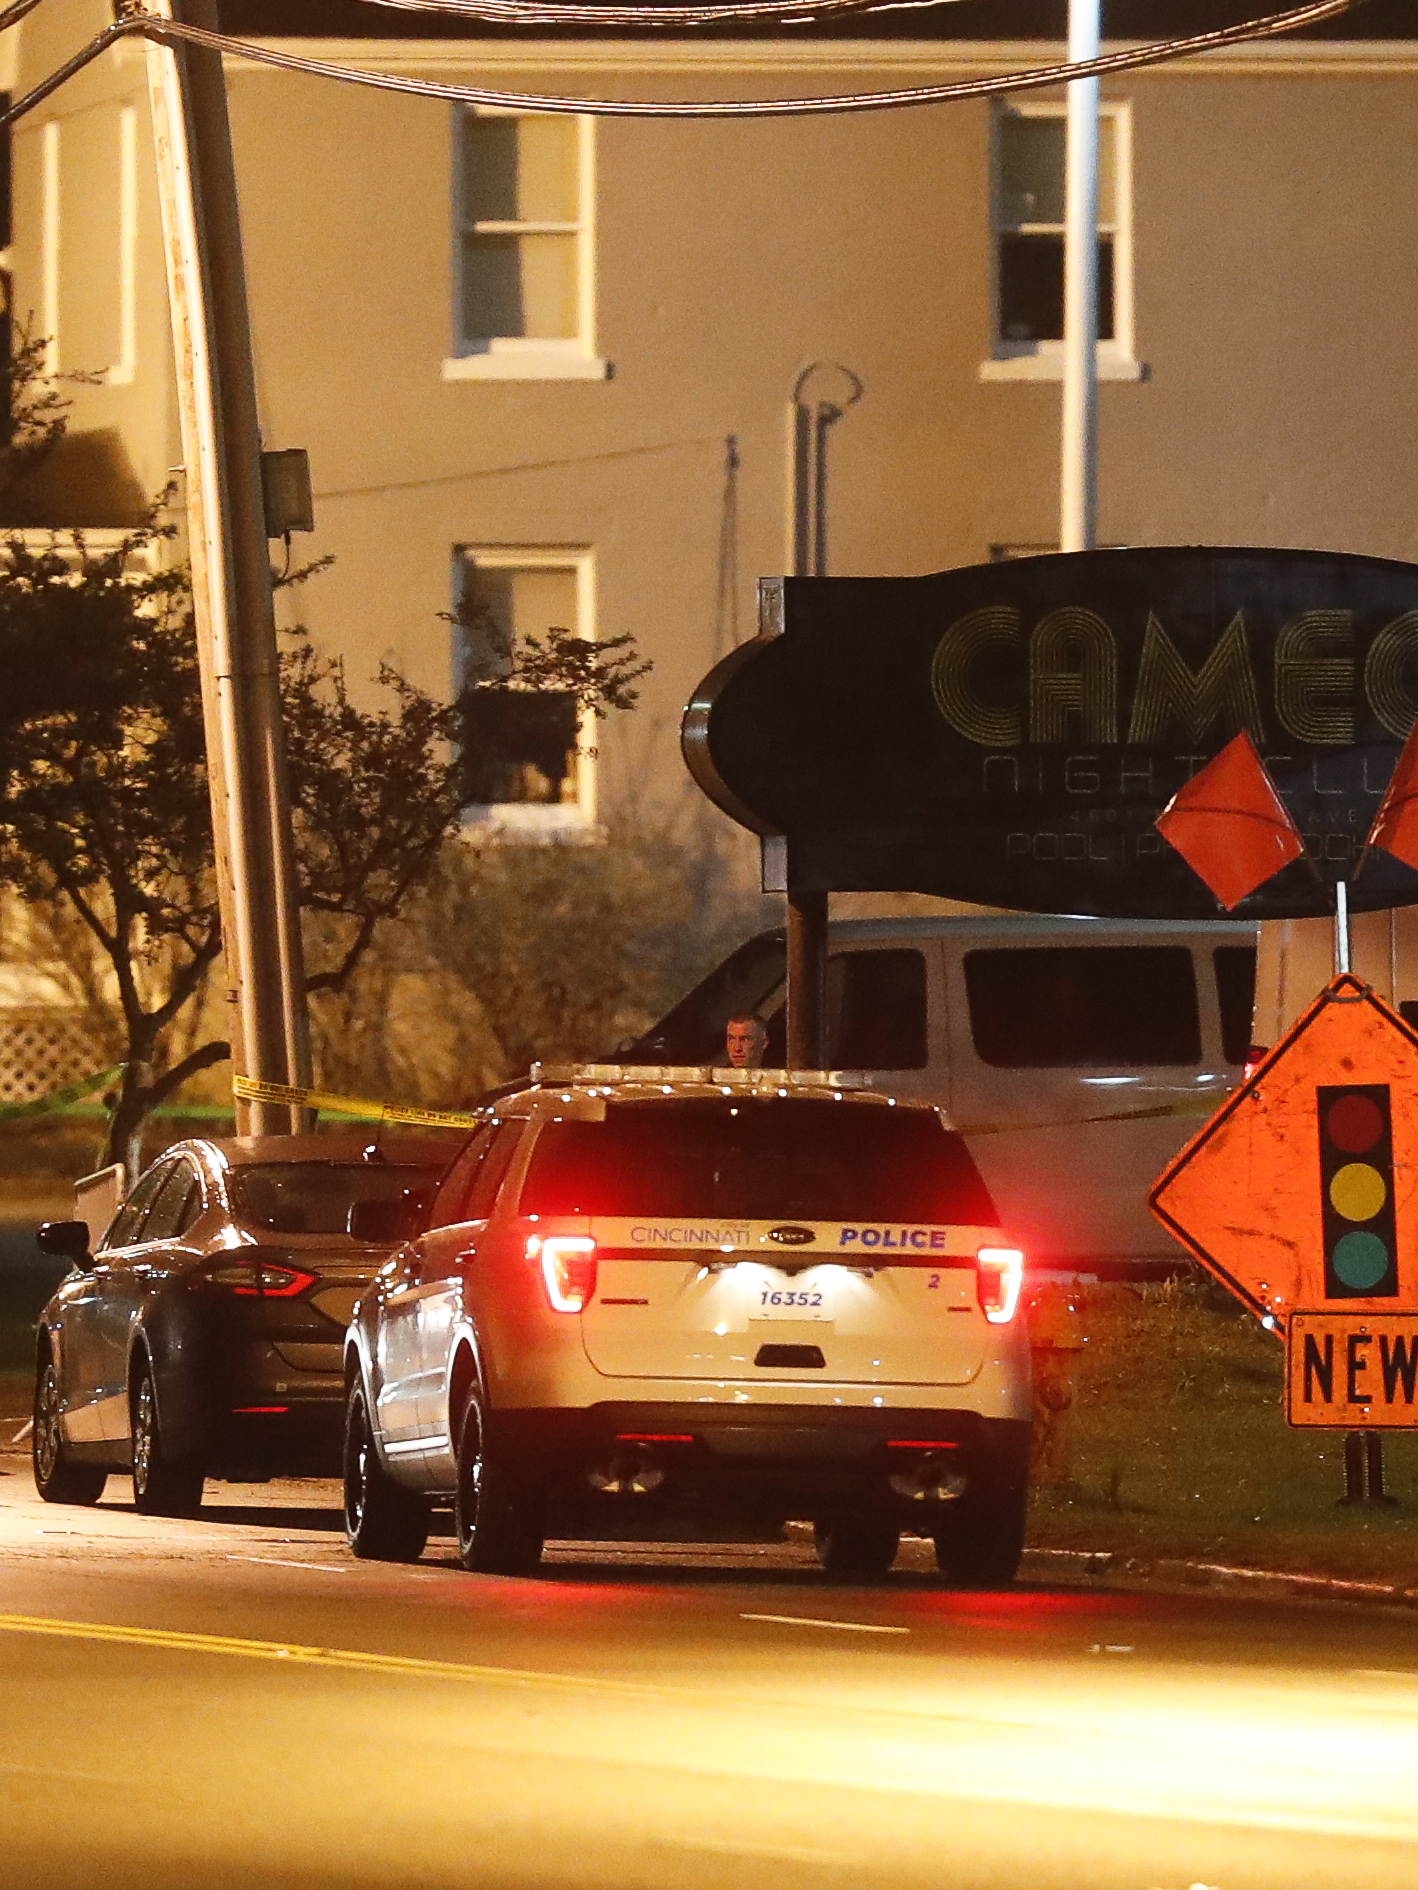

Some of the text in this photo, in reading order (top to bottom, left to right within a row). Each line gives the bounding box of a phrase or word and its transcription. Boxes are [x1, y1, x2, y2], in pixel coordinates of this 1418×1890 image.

[630, 1225, 750, 1244] CINCINNATI
[839, 1227, 946, 1248] POLICE
[928, 1273, 940, 1290] 2
[761, 1291, 822, 1306] 16352
